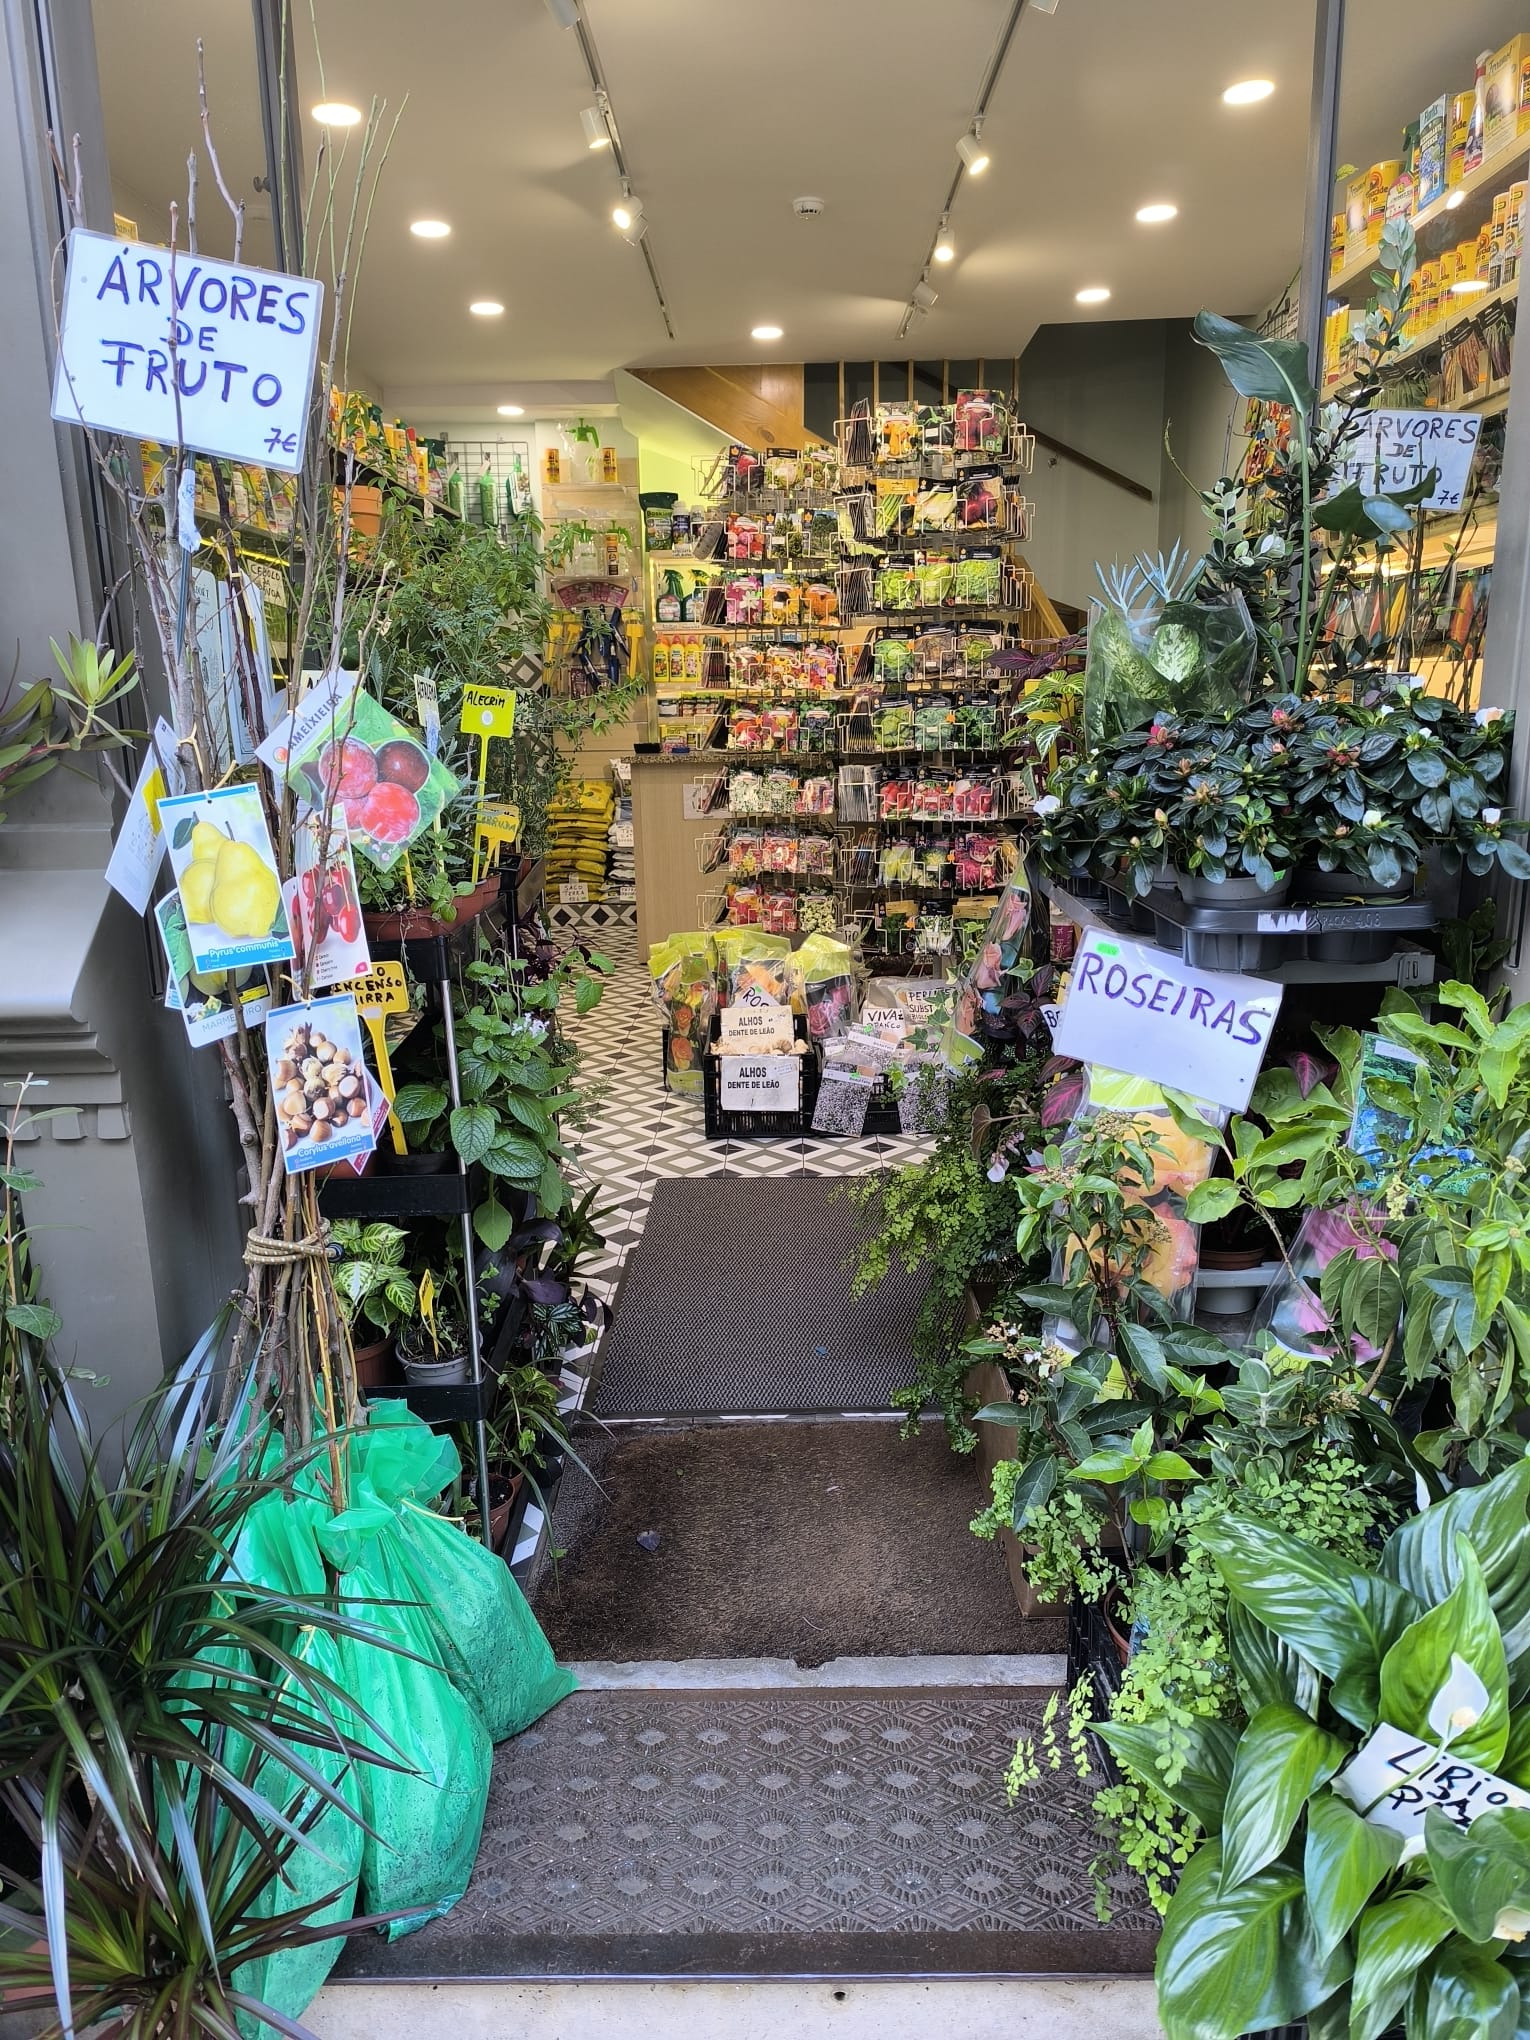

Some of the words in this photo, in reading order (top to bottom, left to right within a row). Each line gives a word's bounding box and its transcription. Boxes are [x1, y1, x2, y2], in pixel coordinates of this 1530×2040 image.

[96, 247, 310, 334] ÁRVORES
[160, 317, 218, 353] DE
[99, 338, 283, 408] FRUTO
[264, 427, 298, 453] 7€
[1385, 442, 1417, 458] DE
[1438, 490, 1460, 505] 7€
[209, 948, 234, 959] Pyrus
[235, 940, 280, 954] communis
[333, 977, 402, 993] INCENSO
[1078, 951, 1272, 1046] ROSEIRAS
[202, 1003, 262, 1032] MARMEIRO
[738, 1016, 763, 1027] ALHOS
[728, 1028, 749, 1037] DENTE
[749, 1028, 758, 1036] DE
[759, 1026, 775, 1035] LEÃO
[739, 1066, 767, 1078] ALHOS
[727, 1081, 750, 1089] DENTE
[751, 1081, 761, 1089] DE
[761, 1079, 780, 1089] LEÃO
[298, 1142, 328, 1158] Corylus
[328, 1134, 362, 1150] avellana
